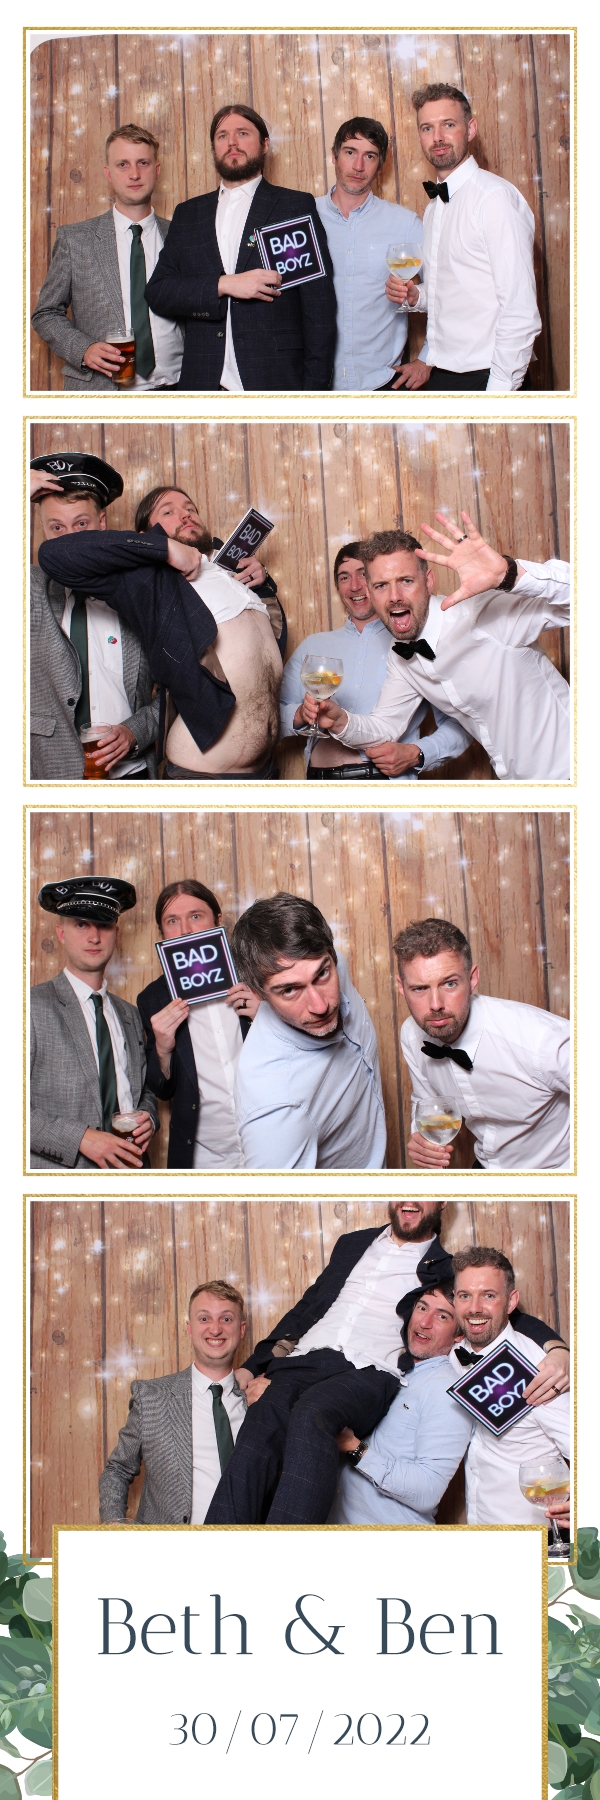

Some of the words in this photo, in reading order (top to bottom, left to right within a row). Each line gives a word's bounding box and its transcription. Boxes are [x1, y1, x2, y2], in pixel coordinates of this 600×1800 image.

[269, 230, 307, 255] BAD
[275, 252, 313, 275] BOYZ
[46, 459, 74, 472] BOY
[239, 523, 262, 546] BAD
[172, 944, 218, 970] BAD
[179, 967, 224, 990] BOYZ
[468, 1362, 514, 1403] BAD
